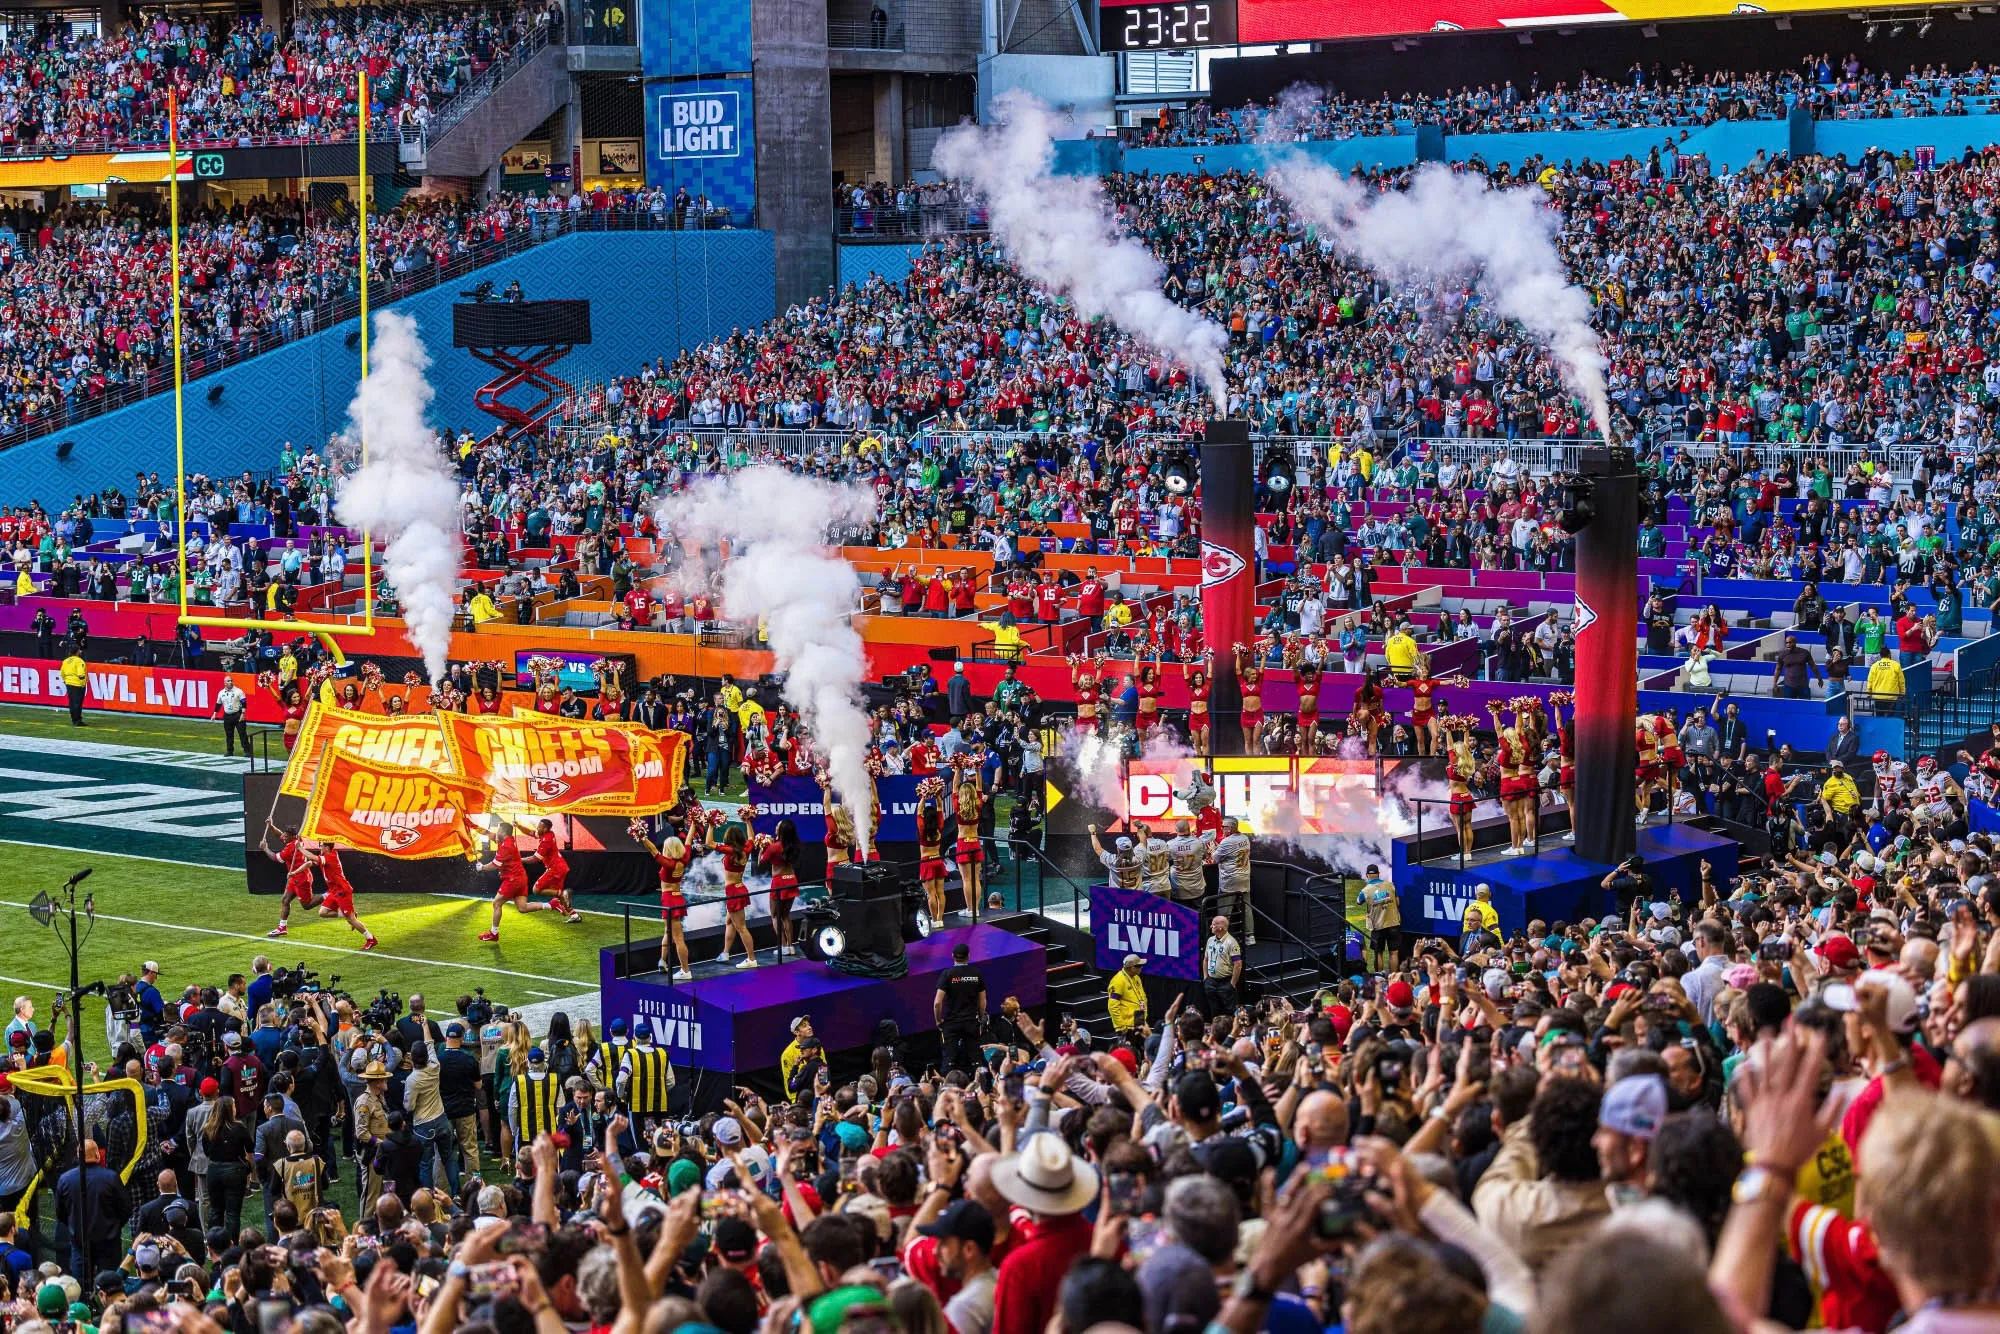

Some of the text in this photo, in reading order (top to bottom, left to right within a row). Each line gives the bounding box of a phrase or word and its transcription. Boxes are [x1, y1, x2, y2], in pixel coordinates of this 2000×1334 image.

[1125, 4, 1211, 46] 23:22
[673, 100, 724, 126] BUD
[664, 126, 734, 152] LIGHT
[198, 156, 223, 174] CC
[1548, 412, 1556, 422] 15
[1952, 482, 1961, 494] 86
[556, 520, 566, 530] 20
[1120, 518, 1134, 531] 87
[1984, 512, 1996, 525] 62
[1, 522, 12, 532] 15
[1961, 526, 1978, 540] 26
[1714, 554, 1730, 567] 33
[1901, 560, 1916, 574] 20
[131, 570, 144, 582] 92
[1043, 589, 1056, 600] 15
[1082, 584, 1096, 595] 87
[634, 597, 646, 609] 15
[568, 662, 586, 673] VS
[48, 669, 136, 702] BWL
[144, 677, 208, 708] LVII
[334, 724, 450, 768] CHIEF
[474, 728, 611, 773] CHIEFS
[924, 752, 937, 768] 15
[537, 780, 560, 795] KC
[756, 802, 824, 815] SUPER
[350, 808, 456, 828] KINGDOM
[390, 830, 414, 844] KC
[1120, 871, 1138, 888] 15
[1430, 882, 1456, 895] SUPER
[1114, 908, 1173, 928] SUPER BOWL
[1108, 923, 1180, 958] LVII
[639, 998, 695, 1020] SUPER BOWL
[633, 1014, 702, 1050] LVII
